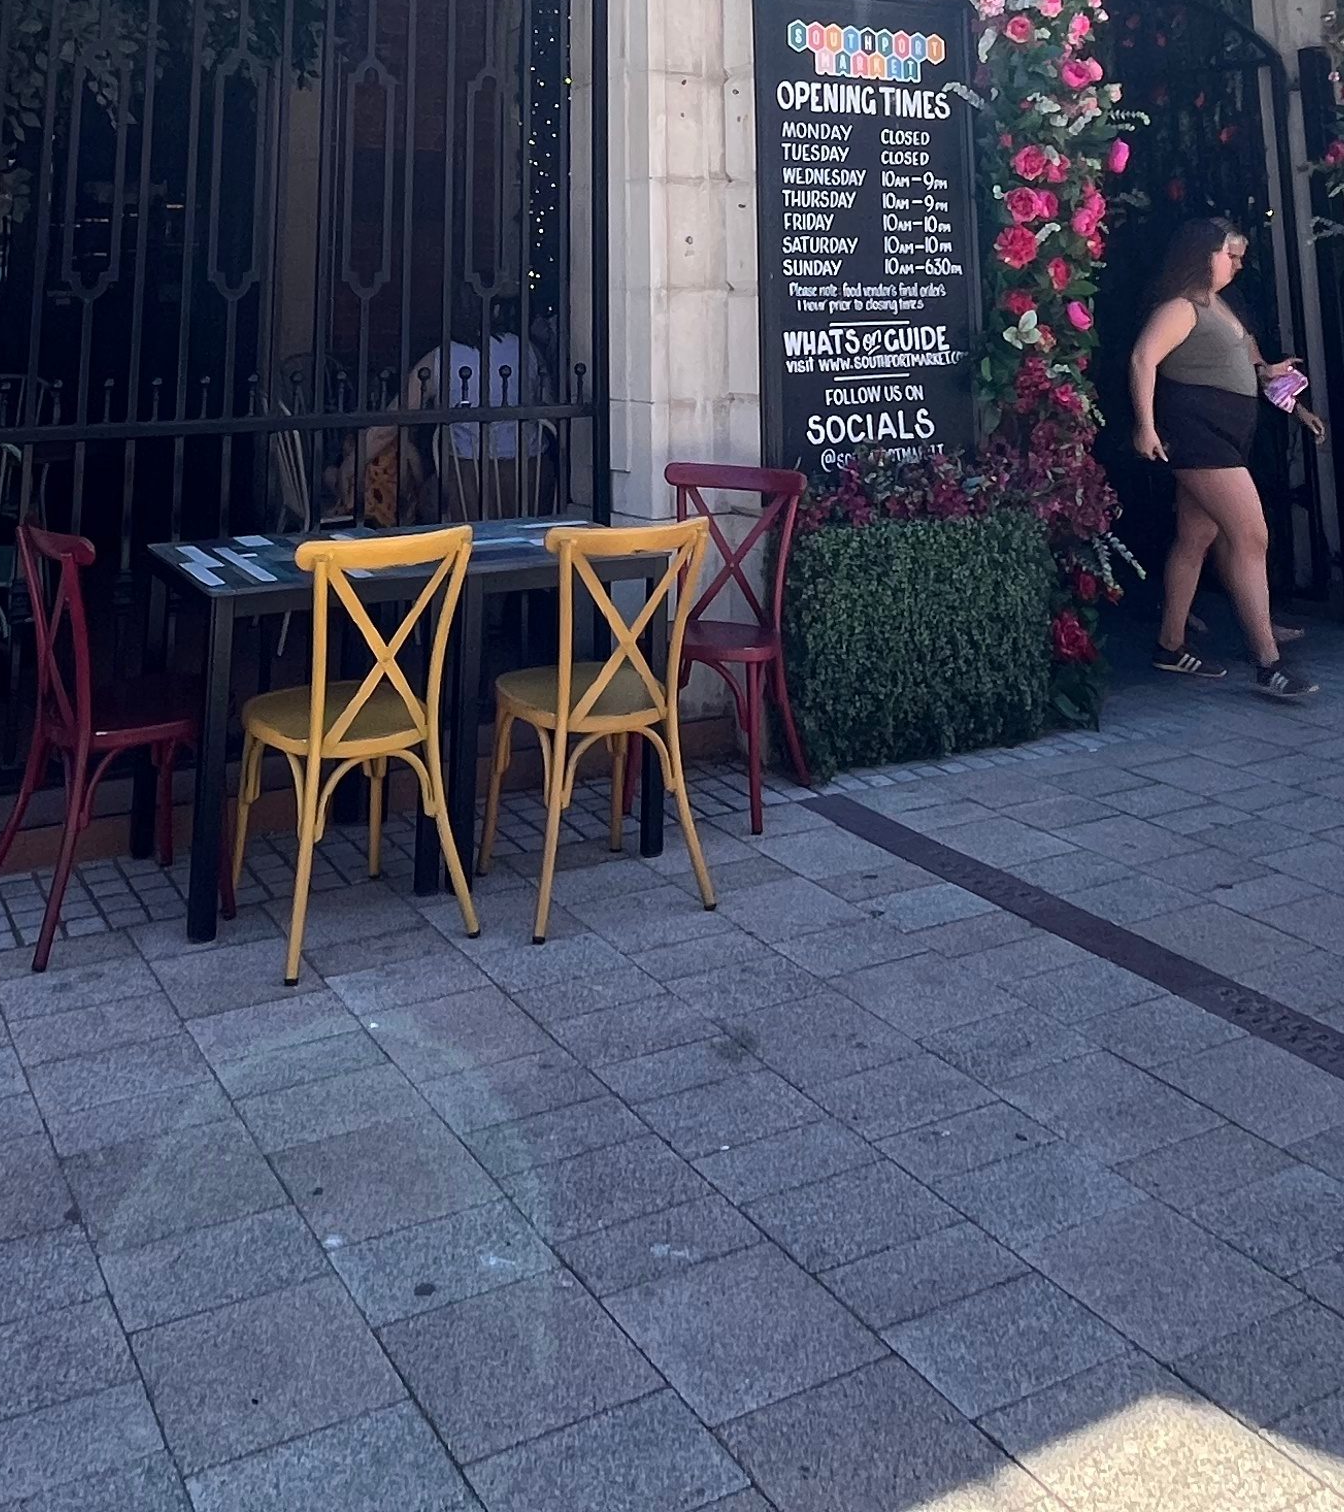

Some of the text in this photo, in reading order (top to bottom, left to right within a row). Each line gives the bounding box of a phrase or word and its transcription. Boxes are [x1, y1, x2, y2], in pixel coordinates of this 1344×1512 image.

[791, 25, 943, 60] SOUTHPORT
[818, 51, 918, 76] MARKET
[777, 80, 951, 119] OPENING TIMES
[781, 121, 930, 146] MONDAY CLOSED
[781, 143, 930, 166] TUESDAY CLOSED
[782, 167, 867, 186] WEDNESDAY
[782, 189, 856, 209] THURSDAY
[783, 213, 834, 231] FRIDAY
[782, 236, 858, 254] SATURDAY
[782, 259, 843, 276] SUNDAY
[789, 282, 817, 297] Please
[819, 283, 837, 297] note
[843, 282, 861, 297] food
[899, 282, 918, 297] final
[803, 299, 828, 311] hour
[829, 300, 852, 314] prior
[854, 298, 863, 311] to
[866, 298, 898, 315] closing
[899, 298, 924, 310] times
[783, 328, 860, 356] WHATS
[883, 326, 950, 351] GUIDE
[825, 384, 924, 406] FOLLOW US ON
[807, 407, 935, 445] SOCIALS
